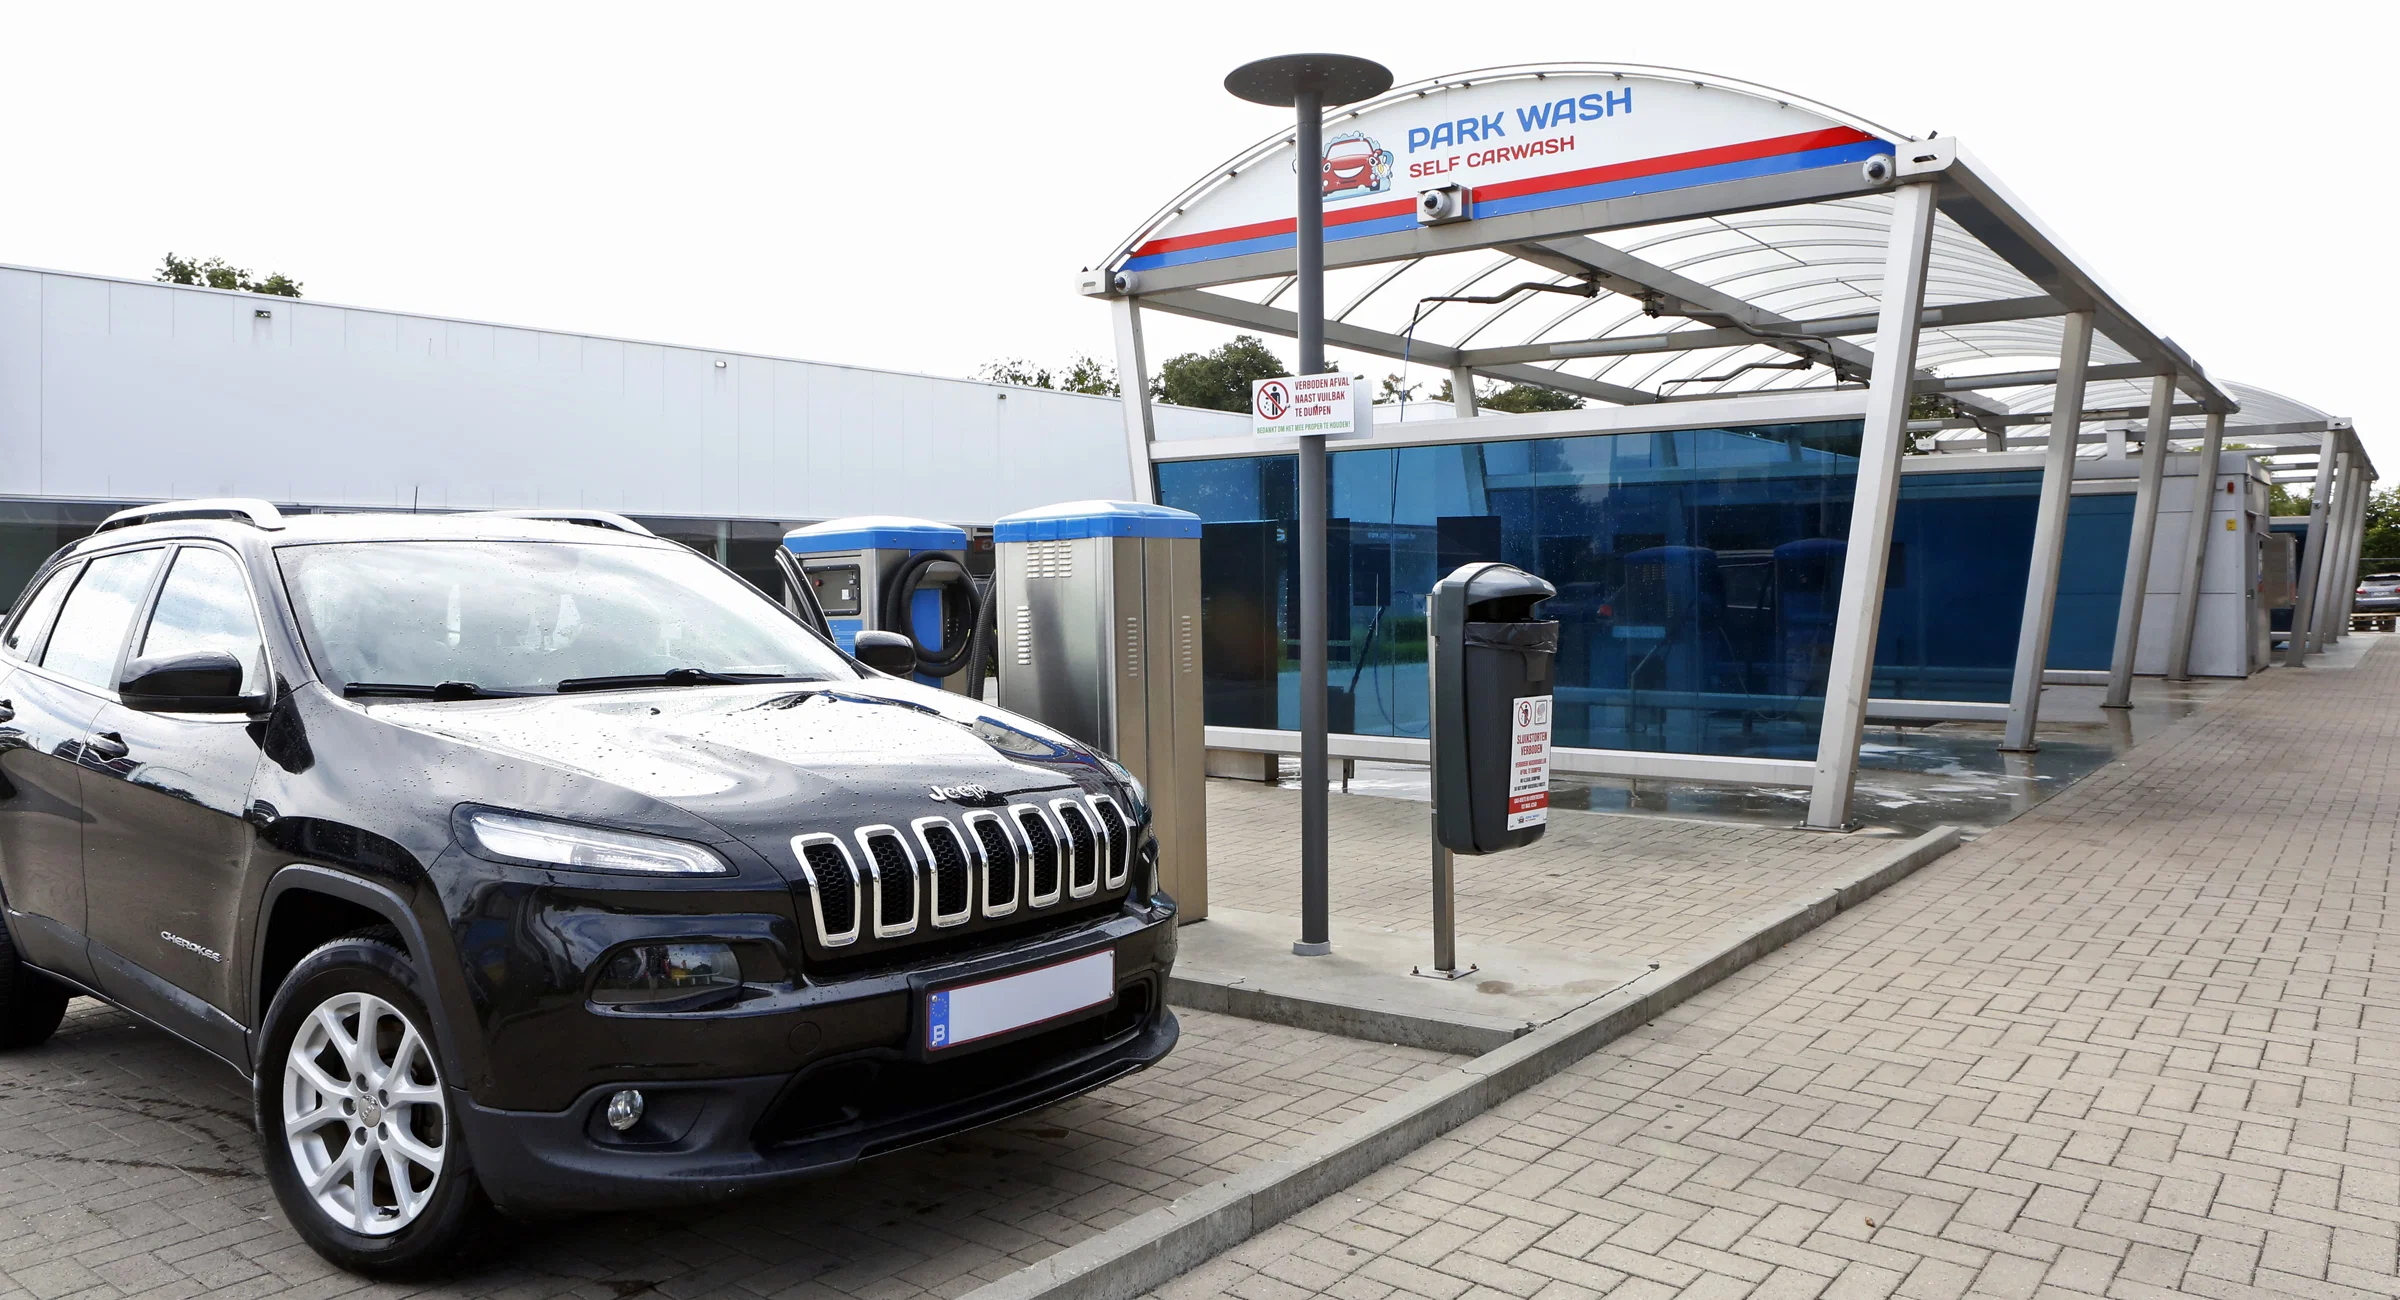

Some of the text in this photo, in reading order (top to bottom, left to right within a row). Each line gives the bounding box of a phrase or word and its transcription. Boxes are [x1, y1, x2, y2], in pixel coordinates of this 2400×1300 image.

[1408, 87, 1632, 153] PARK WASH
[1409, 136, 1575, 178] SELF CARWASH
[1295, 377, 1350, 390] VERBODEN AFVAL
[1295, 391, 1345, 404] NAAST VUILBAK
[1295, 405, 1331, 417] TE DUMPEN
[1257, 426, 1277, 434] BEDANKT
[1305, 422, 1322, 430] PROPER
[1330, 420, 1350, 428] HOUDEN!
[1521, 744, 1542, 755] VERBODEN
[928, 784, 988, 802] Jeep
[161, 931, 222, 962] CHEROKEE
[933, 1025, 946, 1042] B
